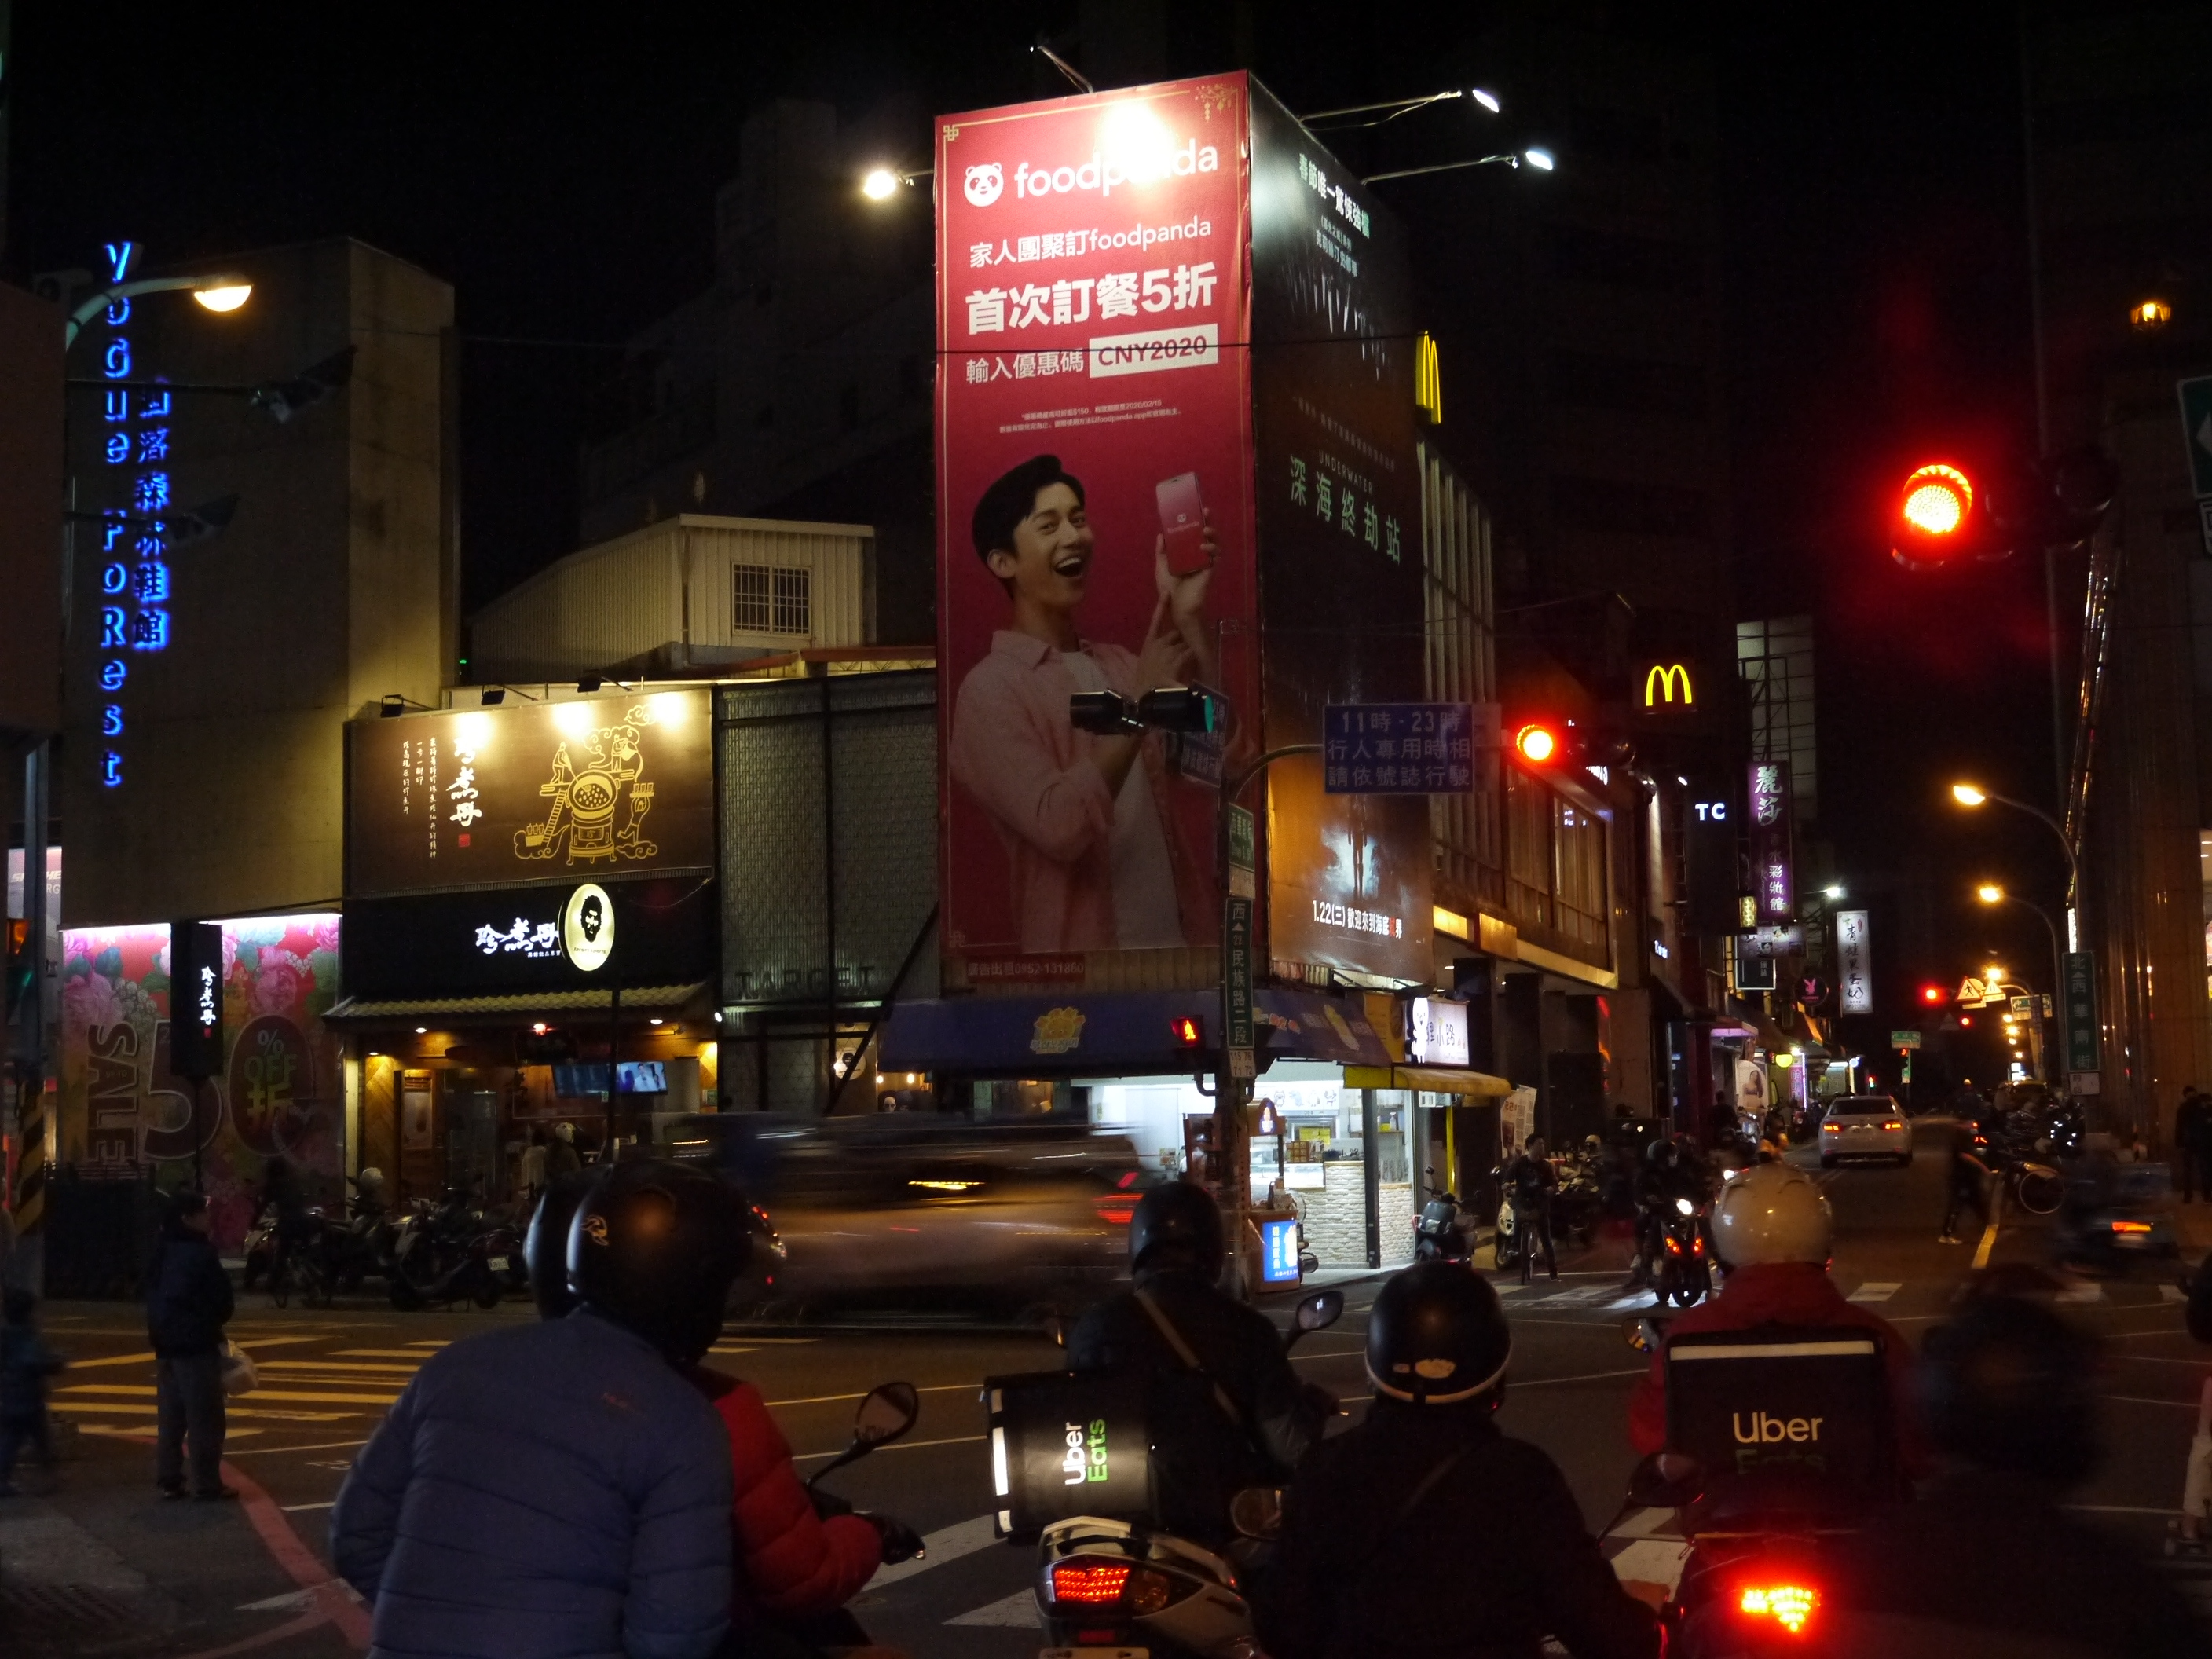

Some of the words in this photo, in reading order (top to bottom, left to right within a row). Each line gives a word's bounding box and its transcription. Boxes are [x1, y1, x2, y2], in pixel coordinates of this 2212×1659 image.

[1014, 137, 1218, 197] foodpda
[969, 216, 1212, 268] 家人團聚訂foodpanda
[965, 261, 1218, 335] 首次訂餐5折
[965, 348, 1084, 385] 輸入優惠碼
[1097, 333, 1208, 368] CNY2020
[1319, 449, 1373, 495] UNDERWATER
[1328, 738, 1470, 761] 行人專用時相
[1328, 765, 1470, 788] 請依號誌行駛
[1694, 802, 1726, 822] TC
[474, 917, 559, 954] 珍煮丹
[1232, 903, 1246, 921] 西
[199, 965, 217, 1026] 珍煮丹
[1232, 950, 1247, 1045] 民族路二段
[86, 1020, 140, 1163] SALE
[1062, 1421, 1086, 1485] Uber
[1086, 1419, 1108, 1482] Eats
[1733, 1411, 1823, 1444] Uber
